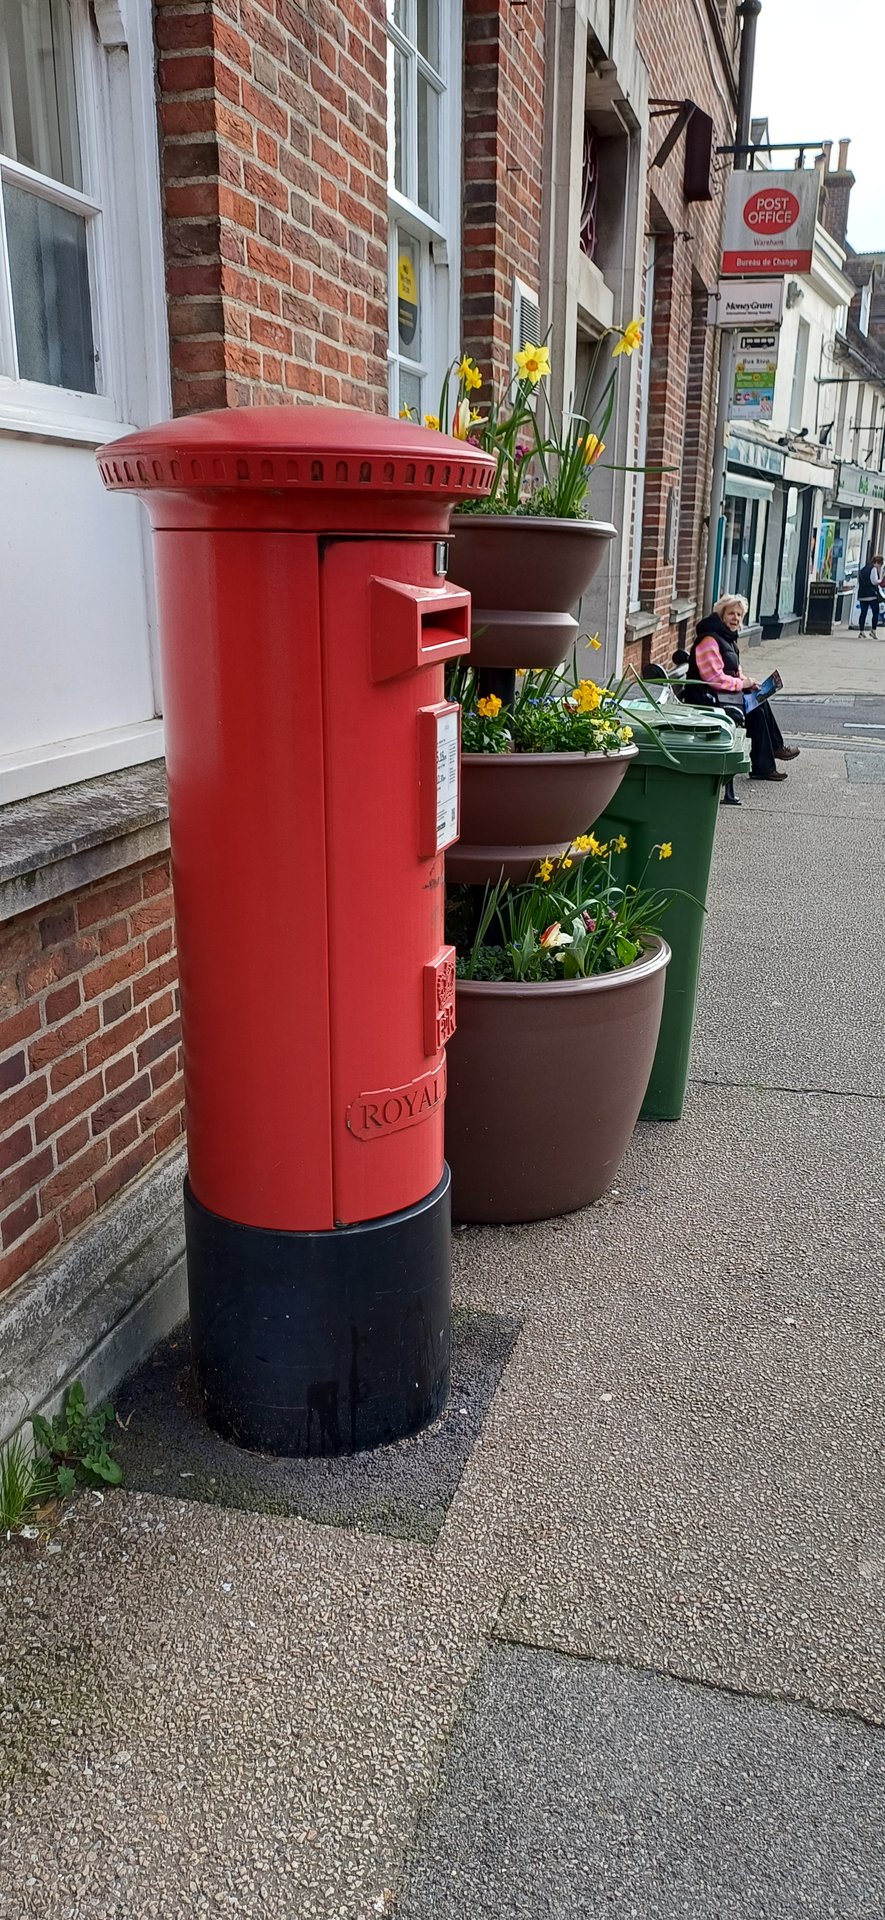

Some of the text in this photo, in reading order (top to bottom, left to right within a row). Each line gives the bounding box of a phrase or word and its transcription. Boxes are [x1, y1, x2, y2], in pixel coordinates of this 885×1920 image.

[756, 197, 790, 211] POST
[748, 210, 792, 225] OFFICE
[753, 238, 784, 247] Wareham
[736, 257, 798, 267] Bureau de Change
[725, 302, 773, 311] MoneyGram
[360, 1080, 441, 1129] ROYAL
